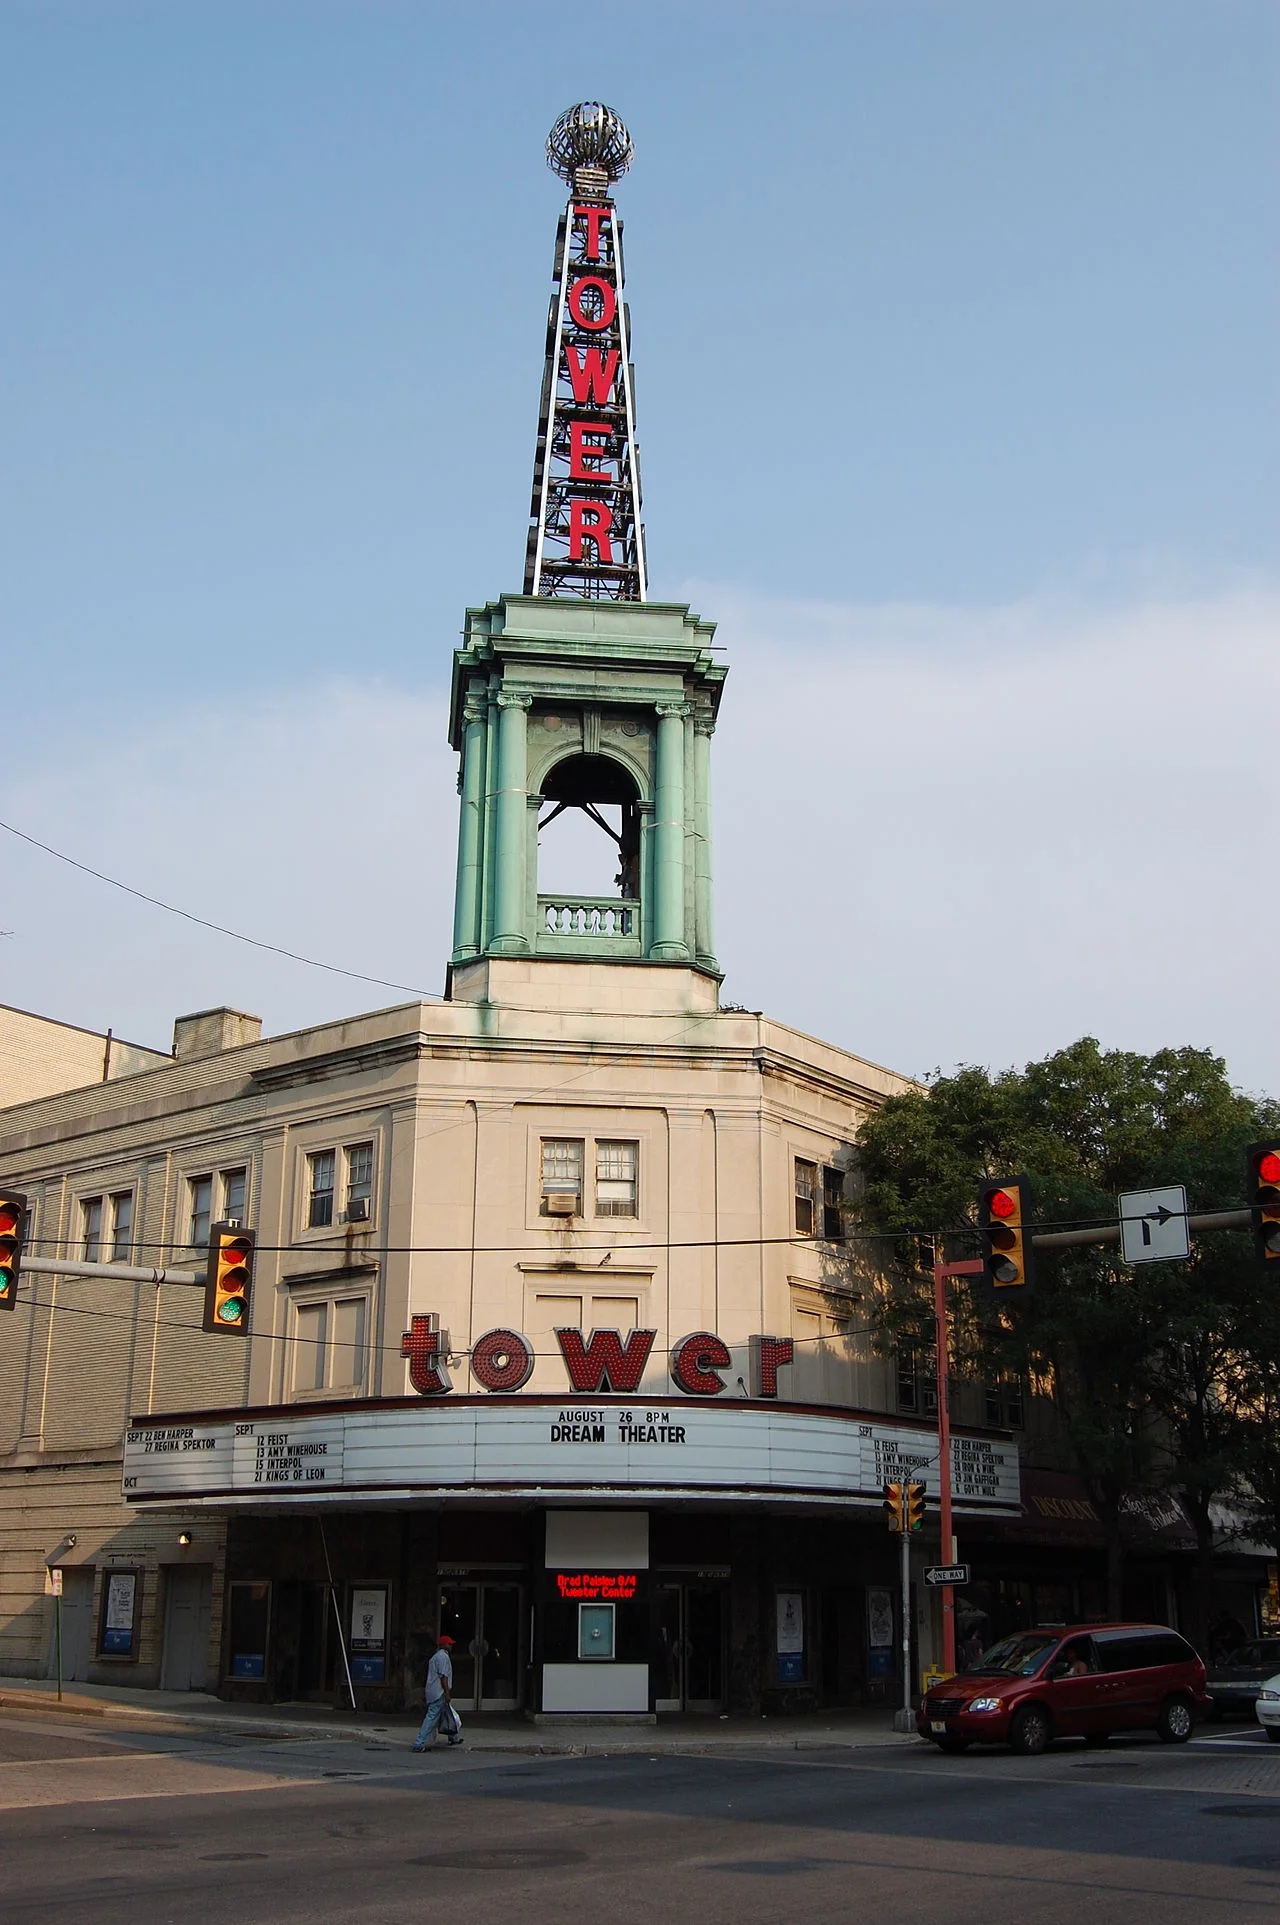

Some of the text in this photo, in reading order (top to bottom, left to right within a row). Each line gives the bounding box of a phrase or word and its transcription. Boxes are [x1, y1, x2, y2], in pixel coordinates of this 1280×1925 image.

[565, 204, 619, 564] TOWER
[400, 1312, 794, 1398] tower
[558, 1411, 670, 1423] AUGUST 26 8PM
[127, 1428, 194, 1442] SEPT 22 BEN HARPER
[235, 1424, 254, 1435] SEPT
[550, 1425, 686, 1443] DREAM THEATER
[858, 1425, 873, 1437] SEPT
[145, 1438, 216, 1452] 27 REGINA SPEKTOR
[257, 1434, 289, 1446] 12 FEIST
[874, 1439, 899, 1453] 12 FEIST
[256, 1443, 328, 1458] 13 AMY WINEHOUSE
[255, 1457, 303, 1470] 15 INTERPOL
[875, 1451, 930, 1468] 13 AMY WINEHOUSE
[254, 1468, 325, 1482] 21 KINGS OF LEON
[875, 1463, 912, 1477] 15 INTERPOL
[124, 1477, 138, 1488] OCT
[875, 1475, 882, 1486] 21
[933, 1570, 963, 1580] ONE WAY
